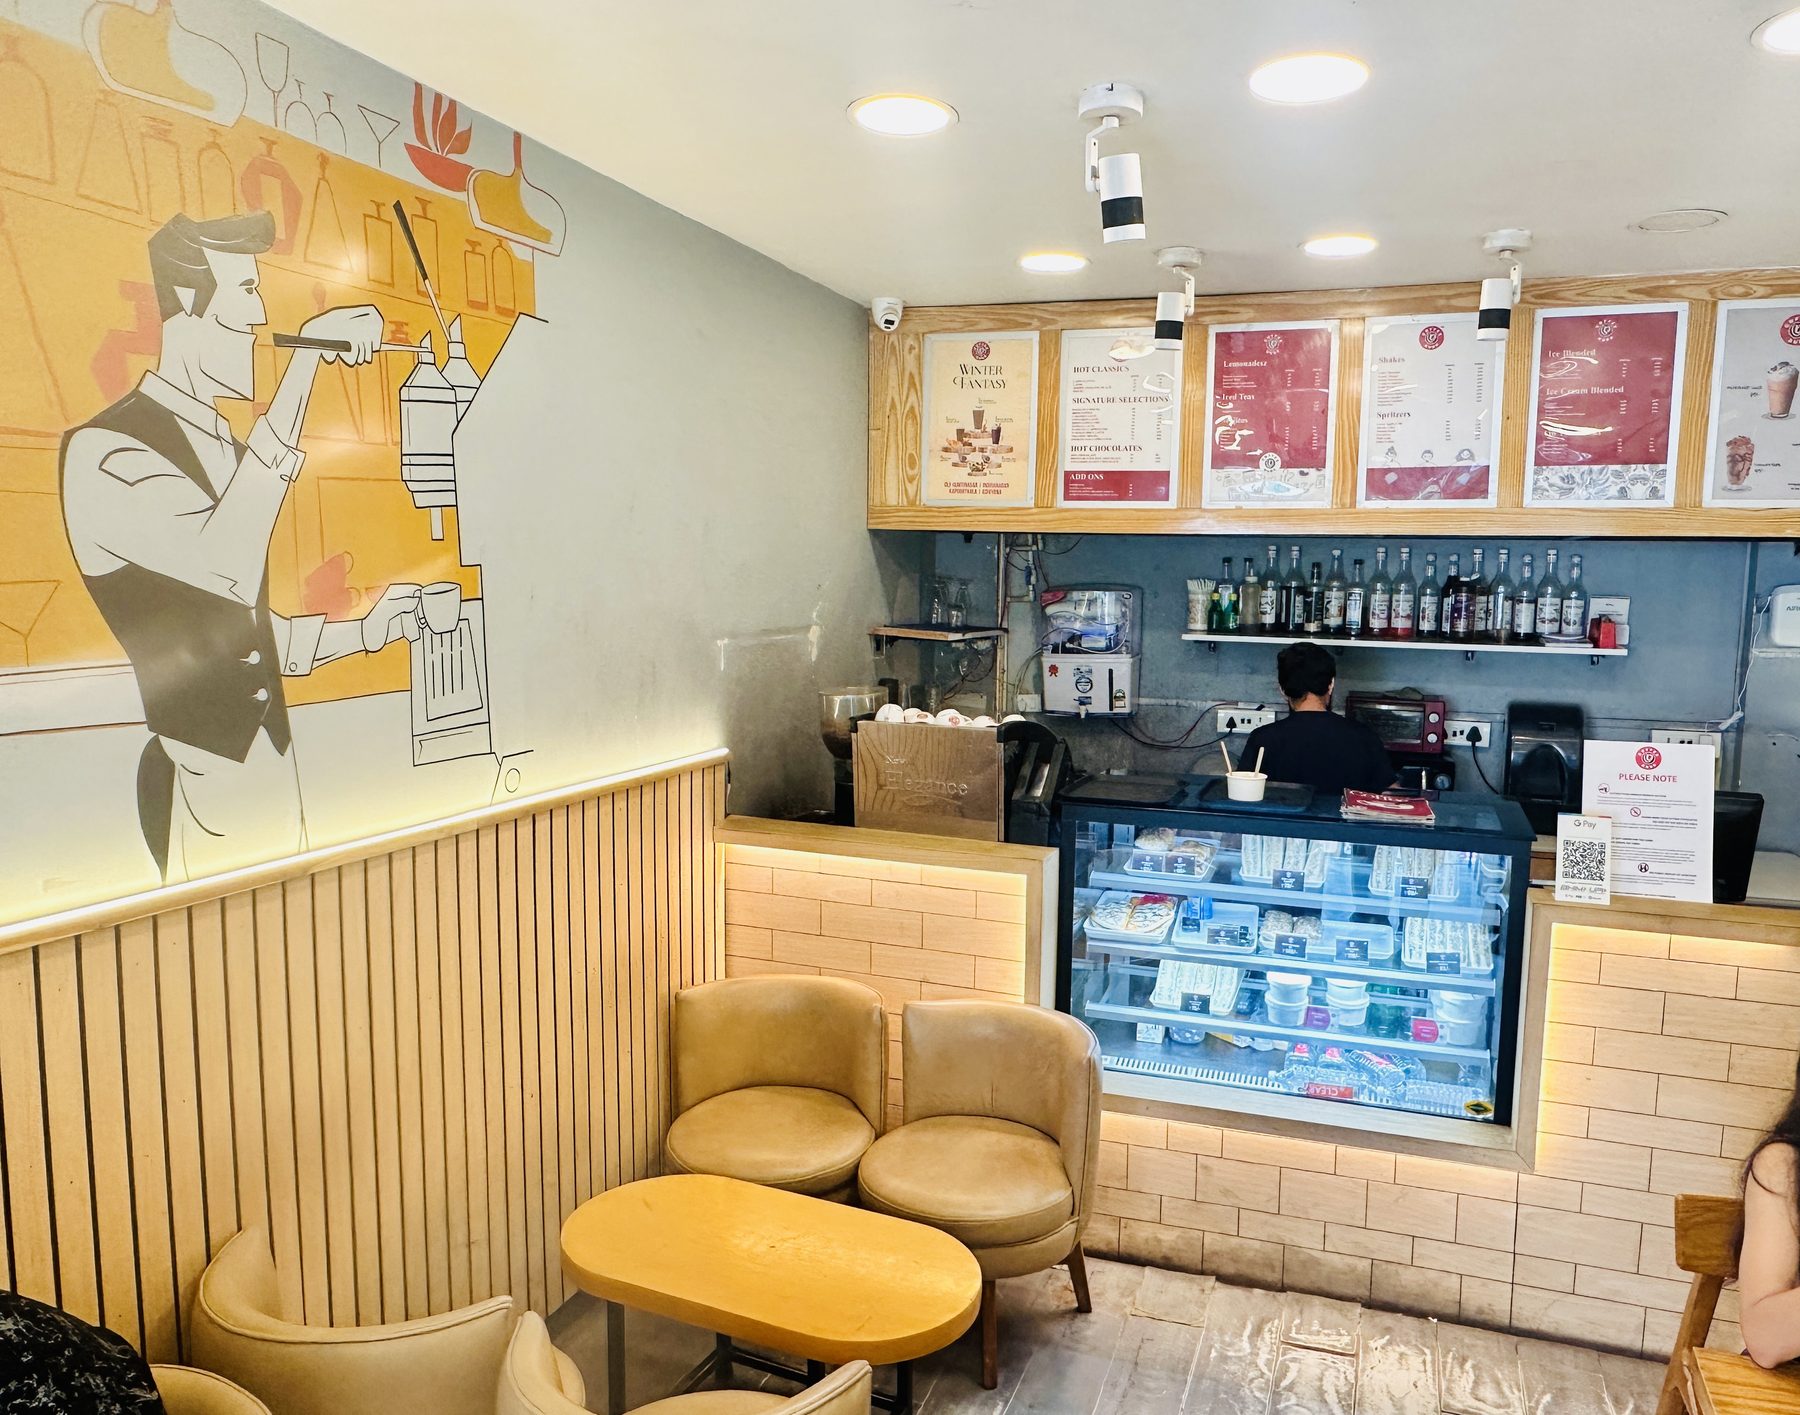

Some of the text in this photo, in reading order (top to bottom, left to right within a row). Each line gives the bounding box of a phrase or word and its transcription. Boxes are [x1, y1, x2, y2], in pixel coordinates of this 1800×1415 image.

[1548, 350, 1560, 358] Ice
[1378, 356, 1406, 364] Shakes
[960, 363, 1003, 376] WINTER
[1092, 365, 1130, 373] CLASSICS
[953, 376, 1007, 390] FANTASY
[1546, 388, 1559, 396] Ice
[1590, 386, 1624, 394] Blended
[1118, 396, 1170, 404] SELECTIONS
[1222, 393, 1255, 401] Iced Teas
[1618, 772, 1678, 783] PLEASE NOTE
[1582, 820, 1597, 830] Pay
